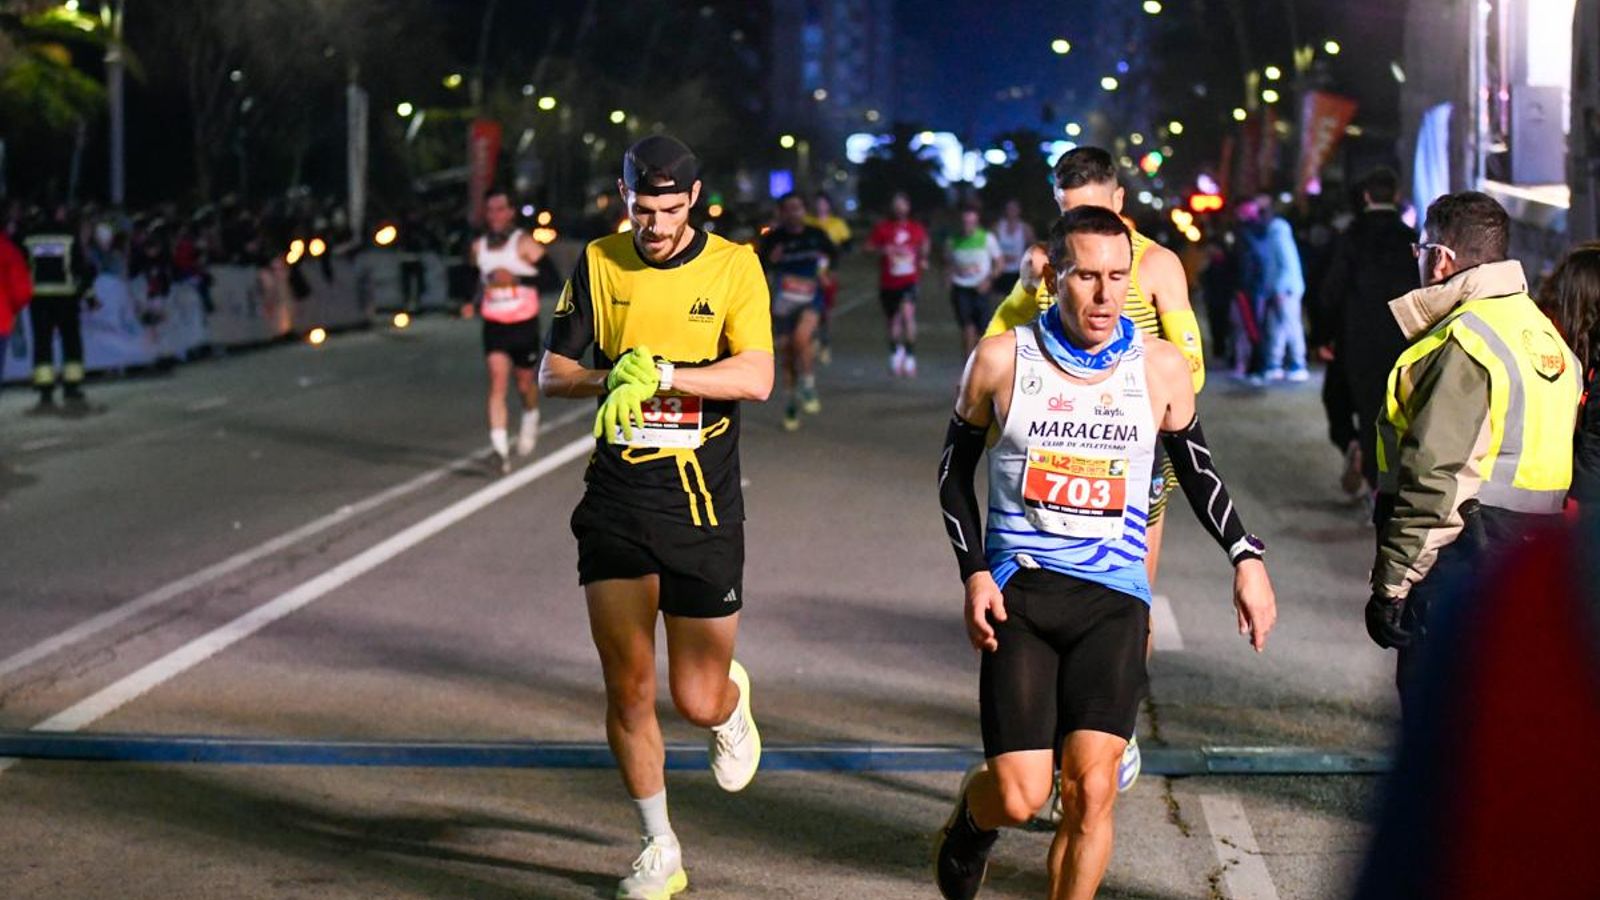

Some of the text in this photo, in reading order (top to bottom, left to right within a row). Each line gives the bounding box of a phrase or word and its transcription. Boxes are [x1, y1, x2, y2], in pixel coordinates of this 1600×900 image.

[630, 397, 683, 422] 33
[1028, 421, 1139, 442] MARACENA
[1080, 442, 1126, 451] ATLETISMO
[1051, 455, 1071, 470] 42
[1045, 472, 1111, 509] 703
